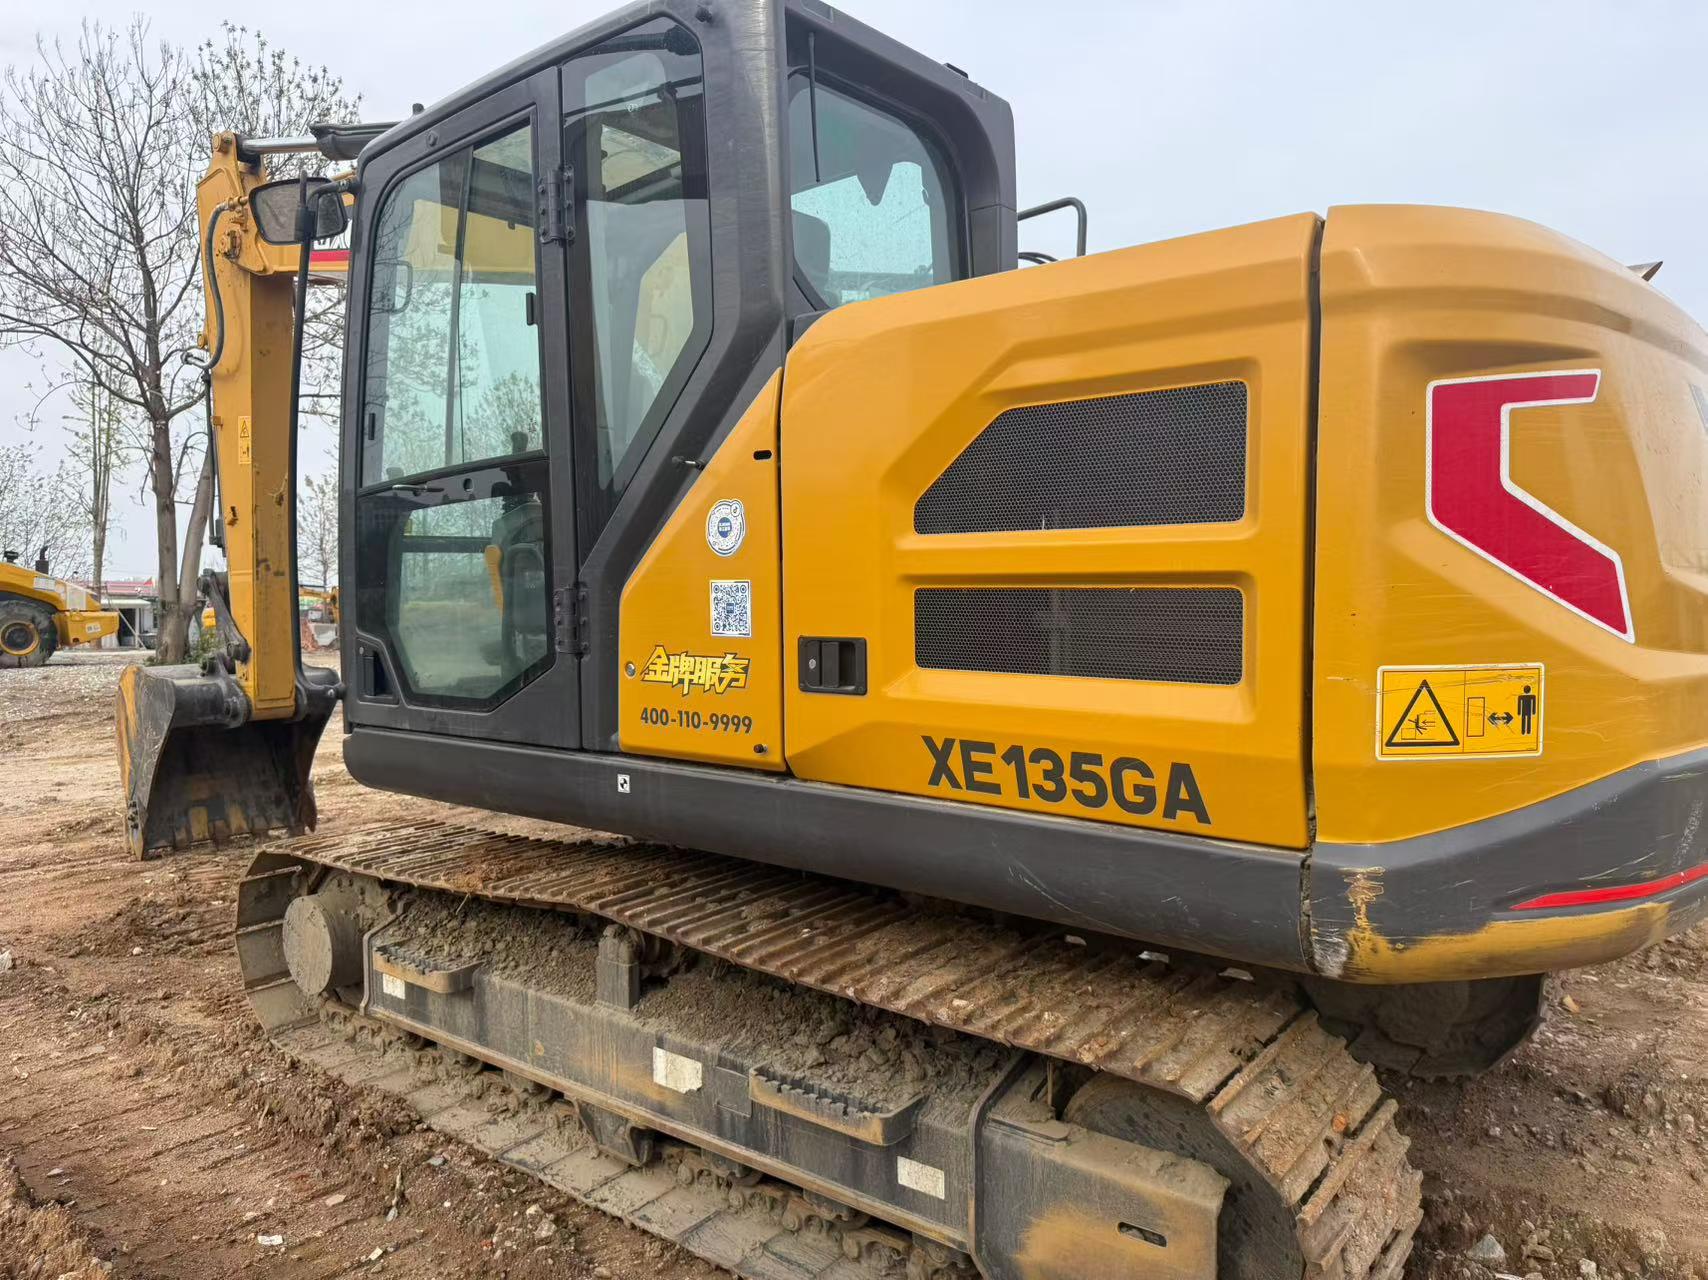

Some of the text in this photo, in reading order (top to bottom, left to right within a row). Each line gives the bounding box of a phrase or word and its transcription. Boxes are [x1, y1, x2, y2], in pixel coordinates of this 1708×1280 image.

[642, 645, 750, 695] 金牌服务
[641, 707, 753, 734] 400-110-9999
[921, 735, 1212, 825] XE135GA
